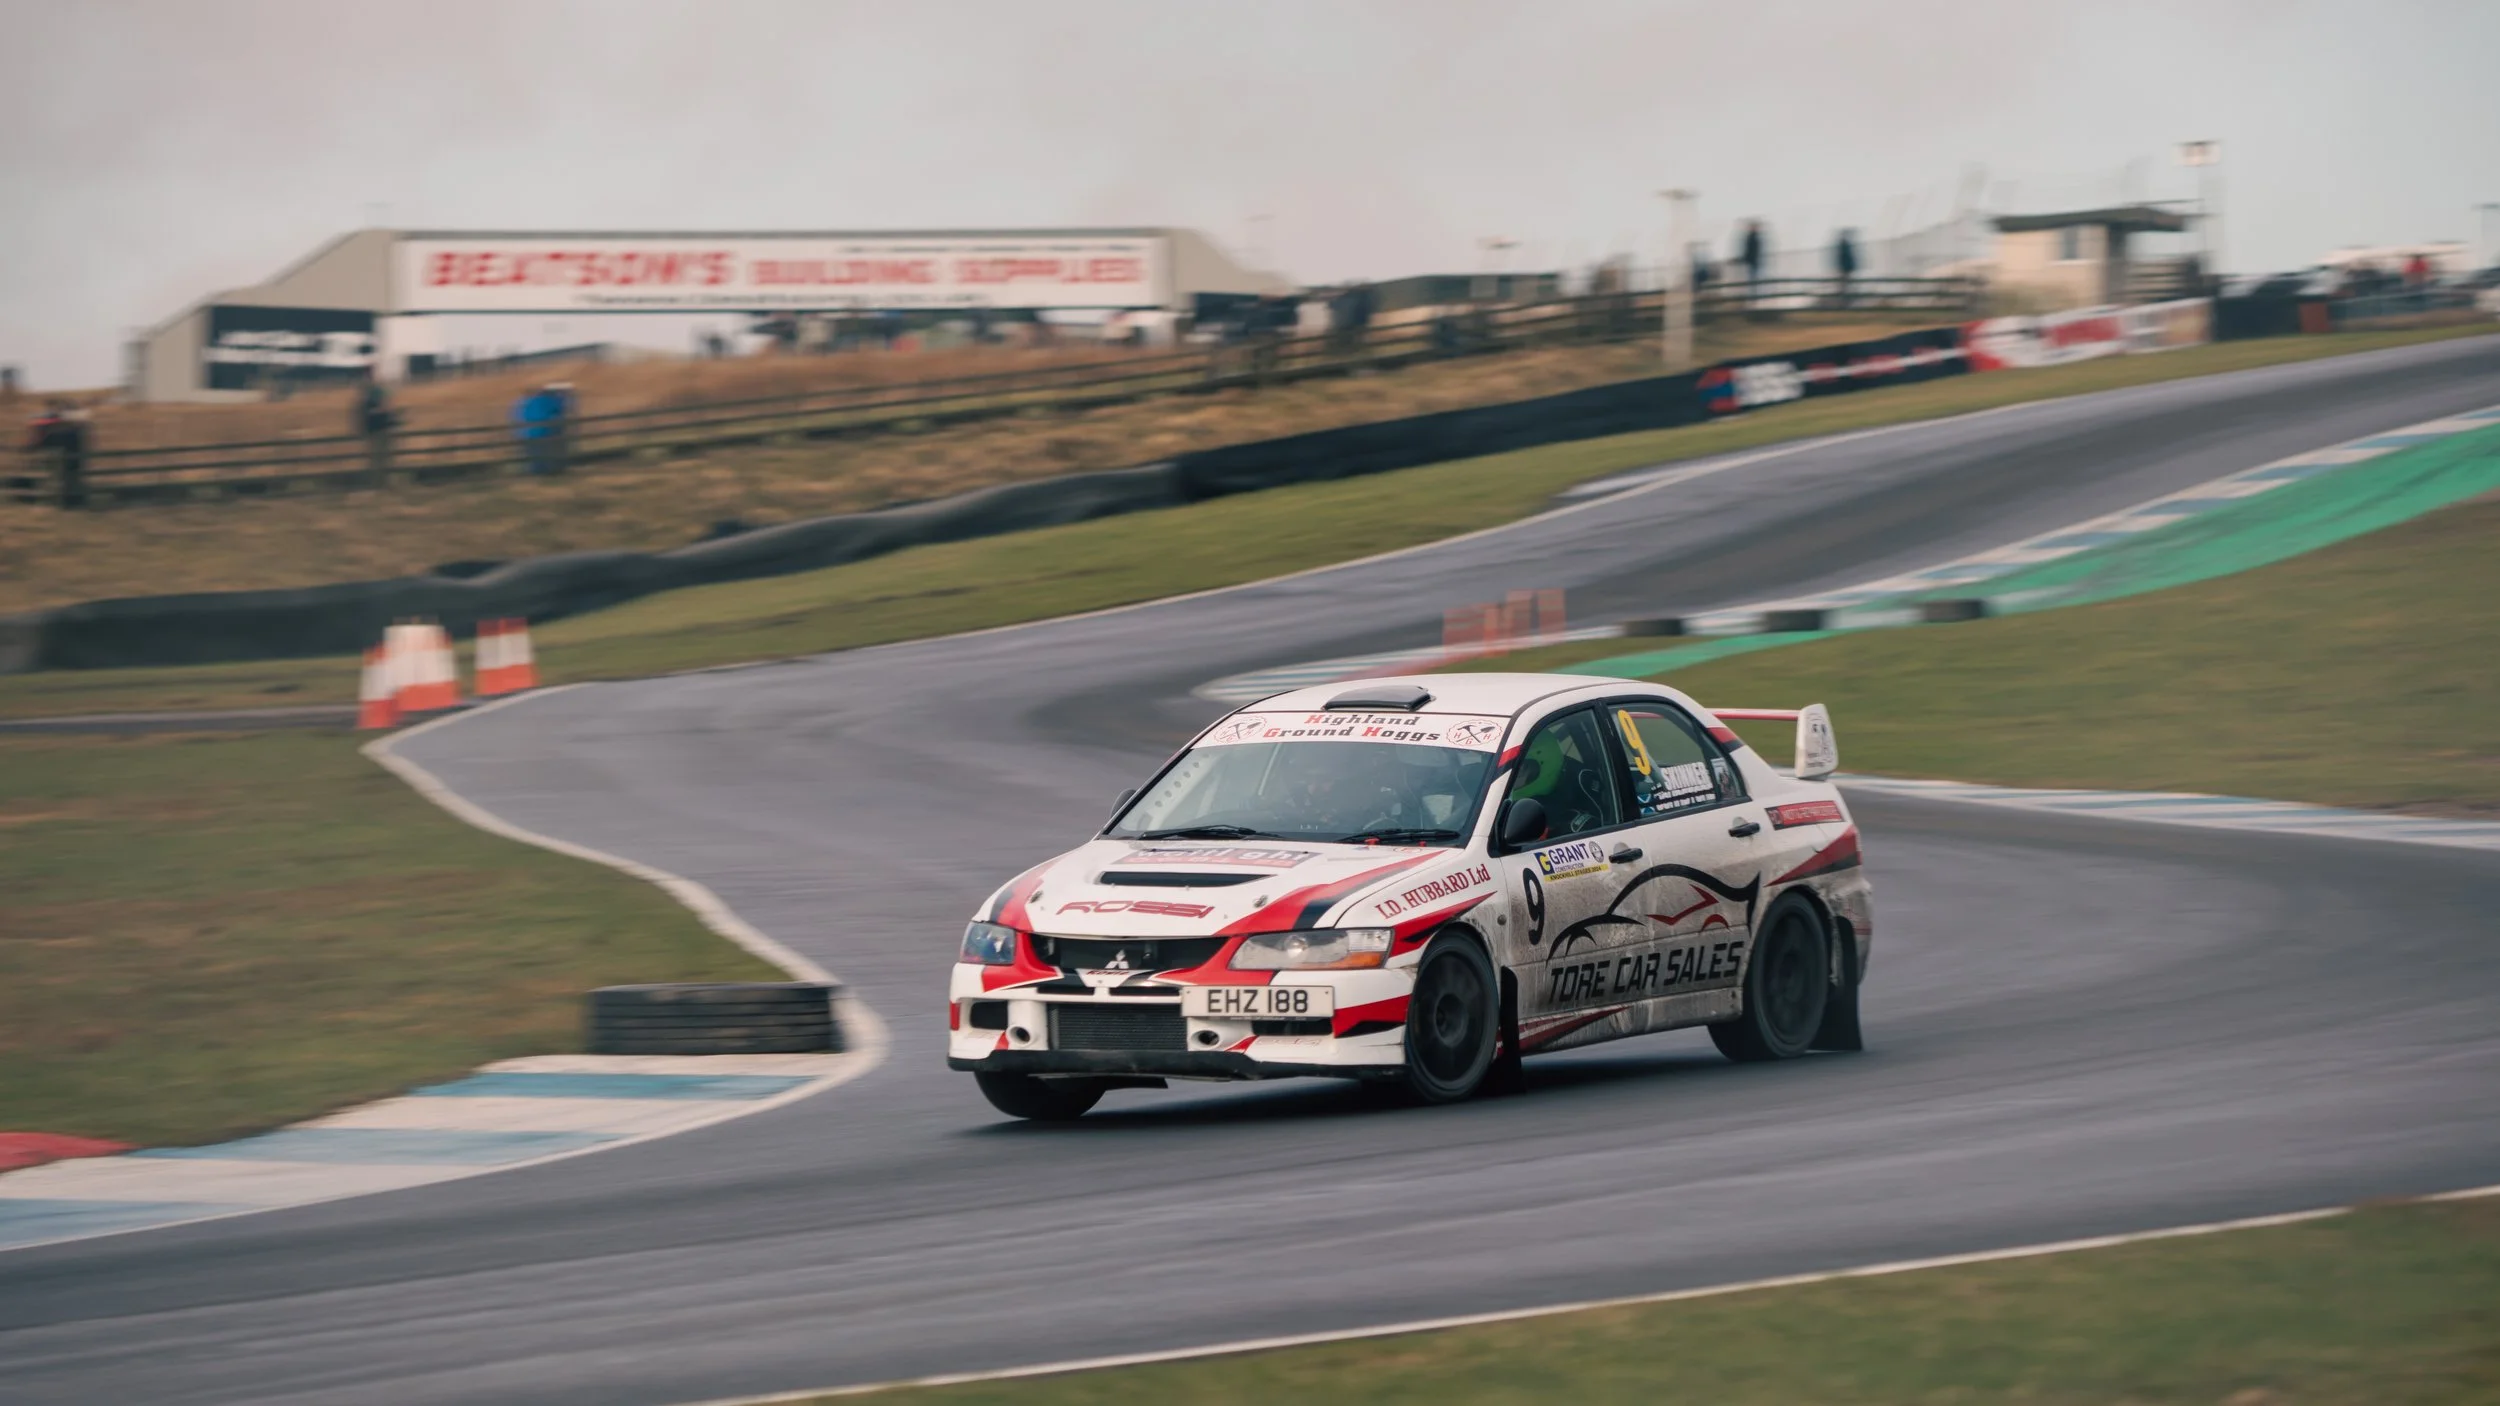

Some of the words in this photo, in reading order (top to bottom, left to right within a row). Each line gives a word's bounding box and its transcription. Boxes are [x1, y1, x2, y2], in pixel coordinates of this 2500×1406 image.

[1304, 714, 1421, 727] Highland
[1263, 726, 1354, 738] Ground
[1361, 726, 1441, 742] Hoggs
[1617, 709, 1652, 776] 9
[1548, 843, 1590, 865] GRANT
[1401, 872, 1470, 909] HUBBARD
[1466, 863, 1492, 886] Ltd
[1550, 872, 1574, 881] KNOCKHILL
[1056, 900, 1215, 919] ROSSI
[1523, 867, 1545, 946] 9
[1551, 960, 1610, 1003] TORE
[1613, 952, 1660, 994] CAR
[1664, 941, 1745, 986] SALES
[1207, 989, 1258, 1013] EHZ
[1267, 989, 1308, 1013] 188
